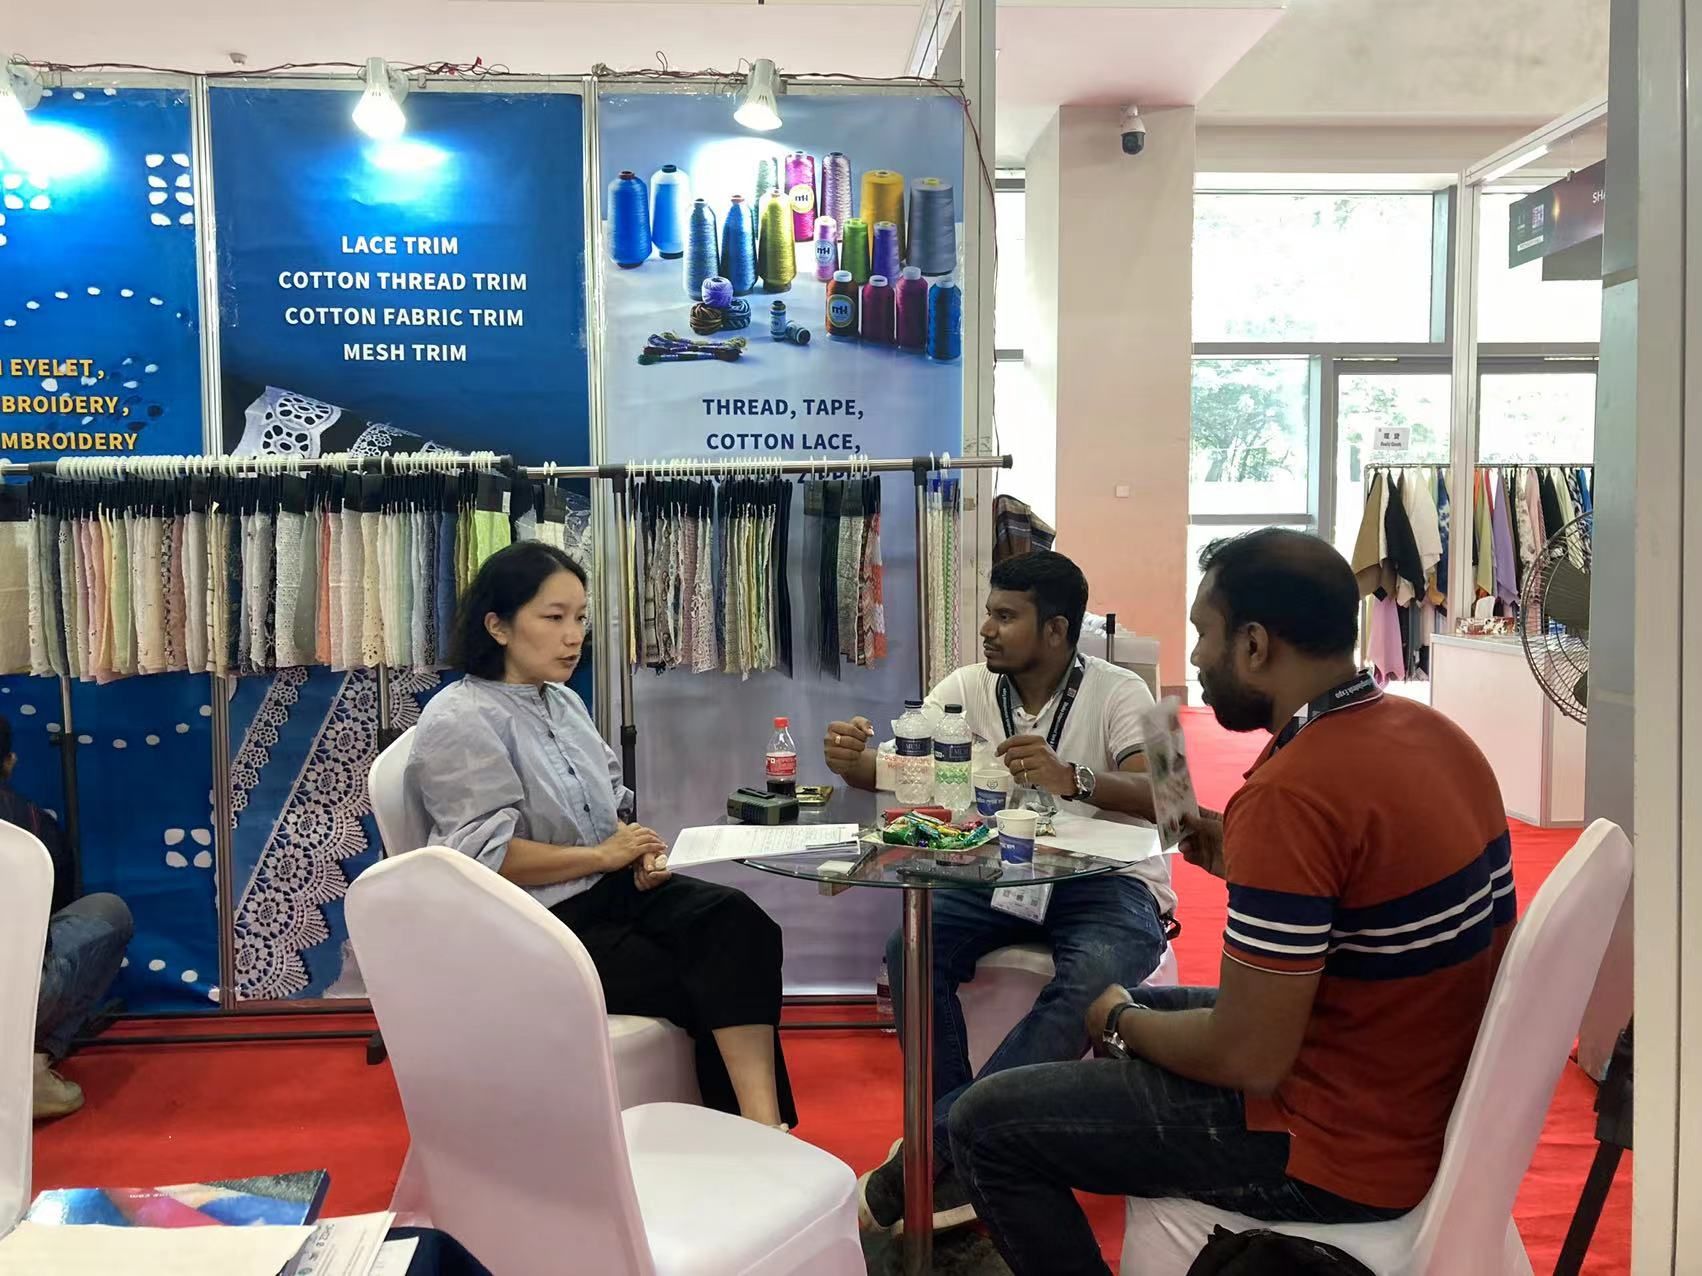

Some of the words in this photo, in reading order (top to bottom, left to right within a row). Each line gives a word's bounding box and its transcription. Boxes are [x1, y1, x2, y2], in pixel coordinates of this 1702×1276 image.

[342, 236, 397, 255] LACE
[402, 236, 458, 255] TRIM
[278, 272, 370, 290] COTTON
[376, 272, 466, 290] THREAD
[472, 273, 527, 291] TRIM
[285, 308, 376, 326] COTTON
[383, 308, 463, 326] FABRIC
[469, 309, 524, 326] TRIM
[343, 344, 405, 361] MESH
[411, 344, 467, 362] TRIM
[11, 359, 105, 379] EYELET,
[2, 396, 129, 416] BROIDERY,
[703, 399, 797, 420] THREAD,
[803, 399, 865, 420] TAPE,
[1, 431, 138, 450] MBROIDERY
[706, 433, 795, 451] COTTON
[801, 433, 862, 454] LACE,
